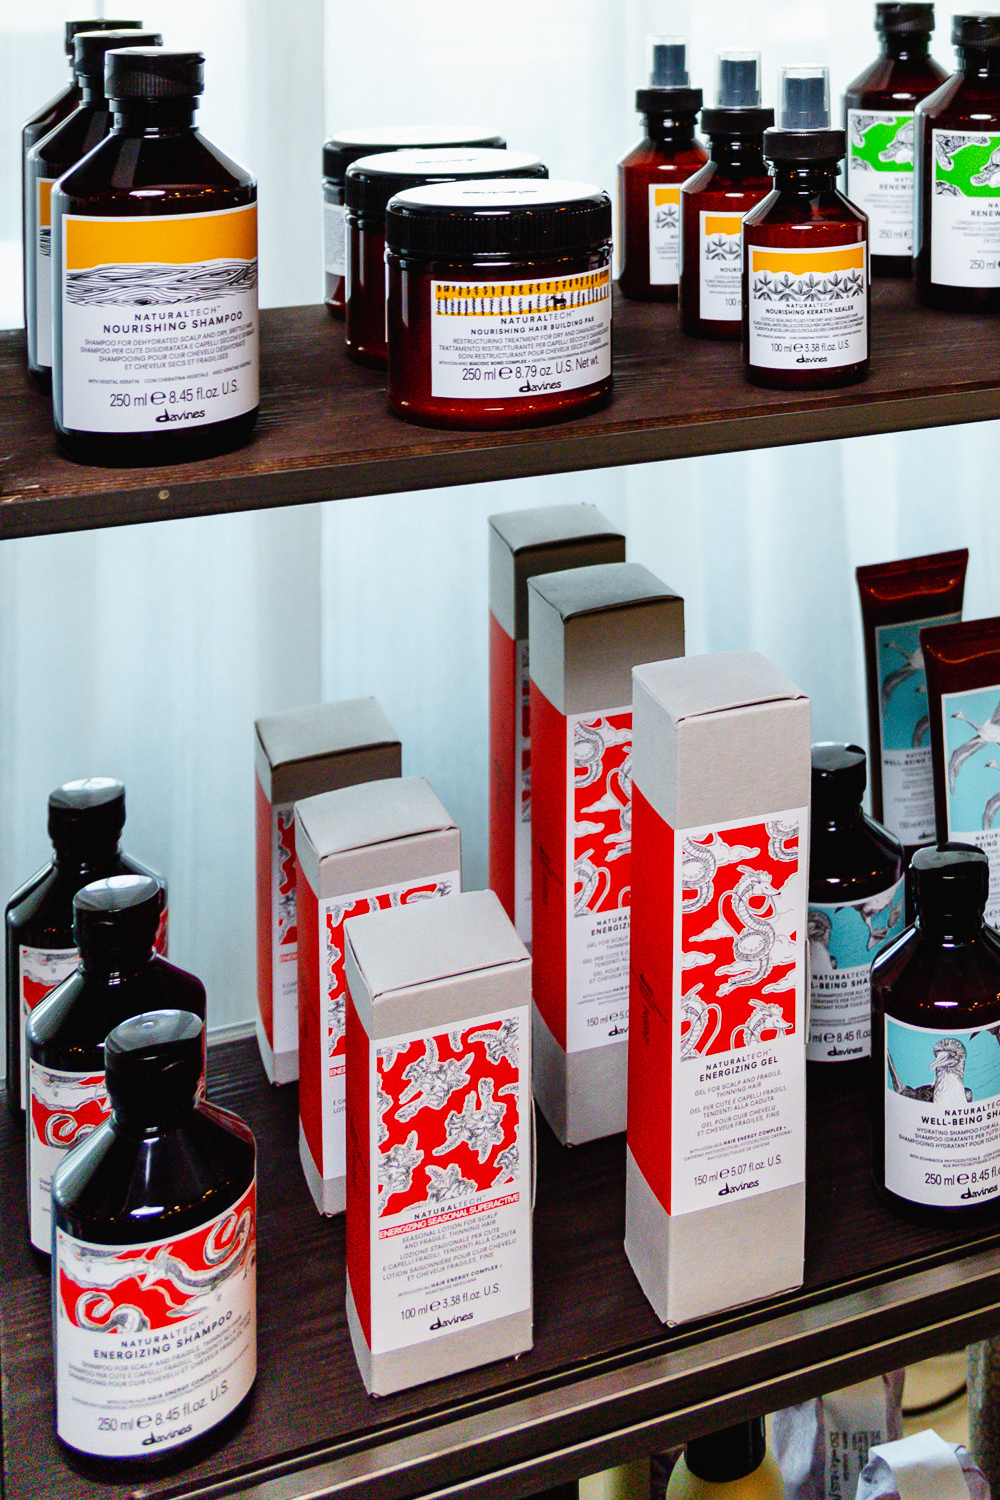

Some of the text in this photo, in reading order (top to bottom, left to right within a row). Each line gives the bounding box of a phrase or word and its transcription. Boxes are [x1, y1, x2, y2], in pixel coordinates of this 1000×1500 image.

[970, 260, 985, 269] 250
[834, 305, 854, 313] SEALER
[104, 311, 243, 333] NOURISHING SHAMPOO
[471, 316, 594, 335] NOURISHING HAIR BUILDING PAK
[133, 336, 178, 345] DEHYDRATED
[180, 334, 201, 343] SCALP
[505, 334, 539, 343] TREATMENT
[99, 351, 185, 362] SHAMPOOING POUR CUIR
[145, 344, 188, 353] DISIDRATATA
[134, 361, 166, 370] CHEVEUX
[796, 354, 828, 364] davines
[462, 358, 589, 381] 250 8.79 Net
[110, 379, 239, 407] 250 ml 8.45 U.S.
[519, 380, 561, 393] davines
[156, 409, 205, 423] davines
[827, 1046, 863, 1056] davines
[700, 1056, 778, 1082] ENERGIZING GEL
[708, 1080, 741, 1093] FOR SCALP
[717, 1082, 761, 1098] THINNING HAIR
[703, 1096, 774, 1118] TENDENTI CADUTA
[922, 1115, 983, 1126] WELL-BEING
[950, 1127, 978, 1135] SHAMPOO
[694, 1164, 746, 1185] 150 5.07
[925, 1169, 990, 1185] 250 8.45
[718, 1179, 759, 1196] davines
[961, 1184, 998, 1200] davines
[379, 1194, 519, 1239] ENERGIZING SEASONAL SUPERACTIVE
[403, 1212, 498, 1243] SEASONAL LOTION SCALP
[401, 1295, 461, 1320] 100 3.38
[429, 1312, 474, 1331] davines
[94, 1310, 233, 1359] ENERGIZING SHAMPOO
[98, 1407, 180, 1431] 250 8.45
[142, 1423, 192, 1446] davines
